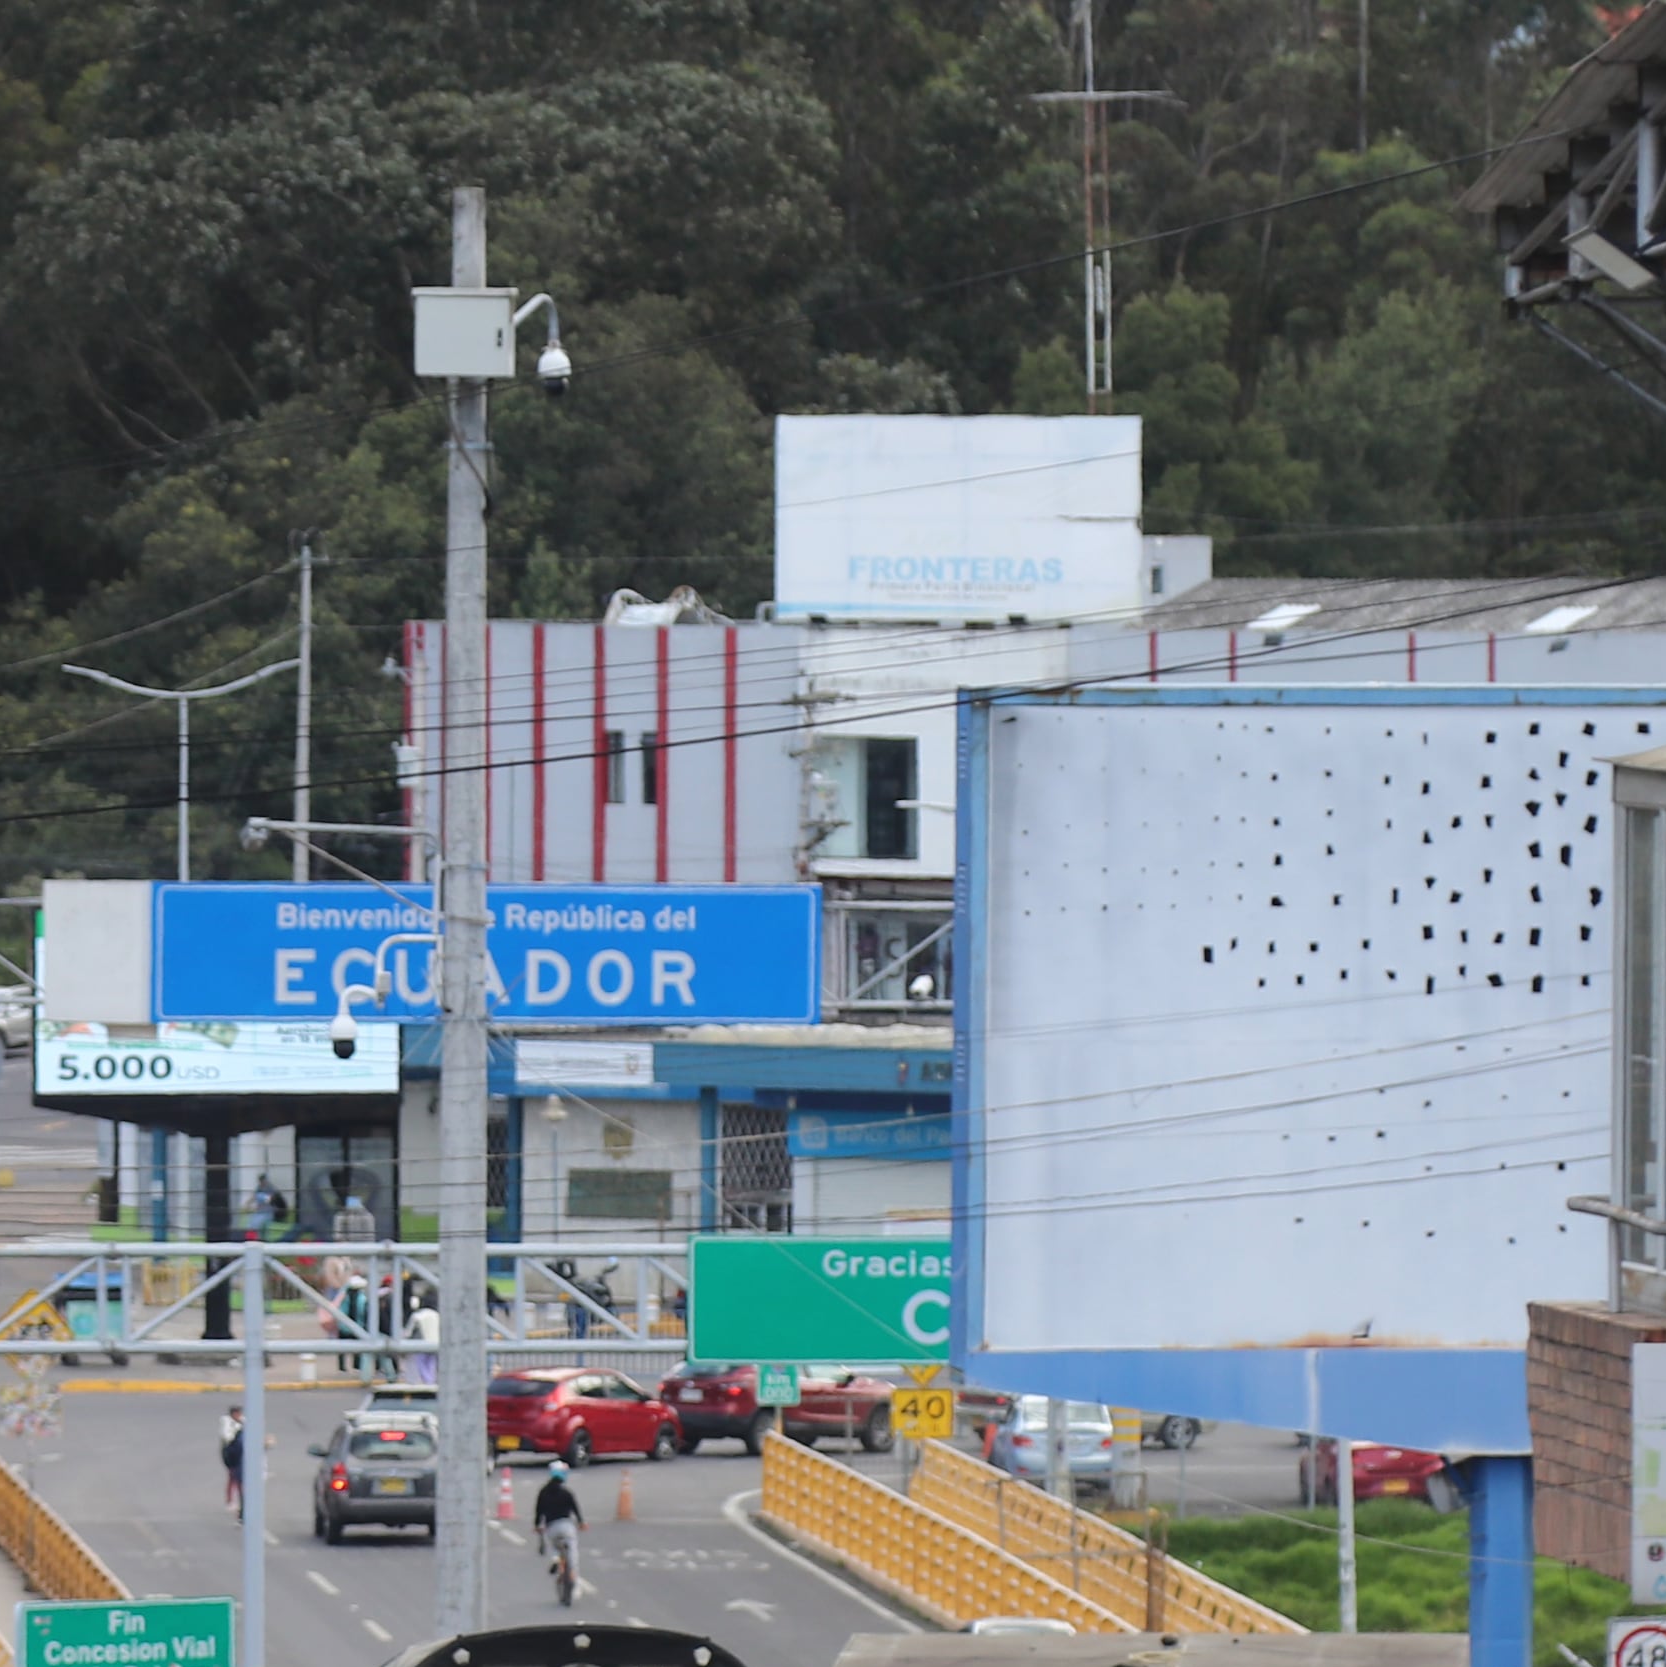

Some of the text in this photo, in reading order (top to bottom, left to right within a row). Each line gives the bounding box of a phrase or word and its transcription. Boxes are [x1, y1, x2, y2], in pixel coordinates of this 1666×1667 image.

[848, 556, 1064, 582] FRONTERAS
[504, 902, 646, 934] República
[653, 904, 696, 931] del
[57, 1055, 220, 1081] 5.000 USD
[900, 1396, 945, 1421] 40
[108, 1611, 146, 1635] Fin
[44, 1636, 216, 1665] Concesion Vial
